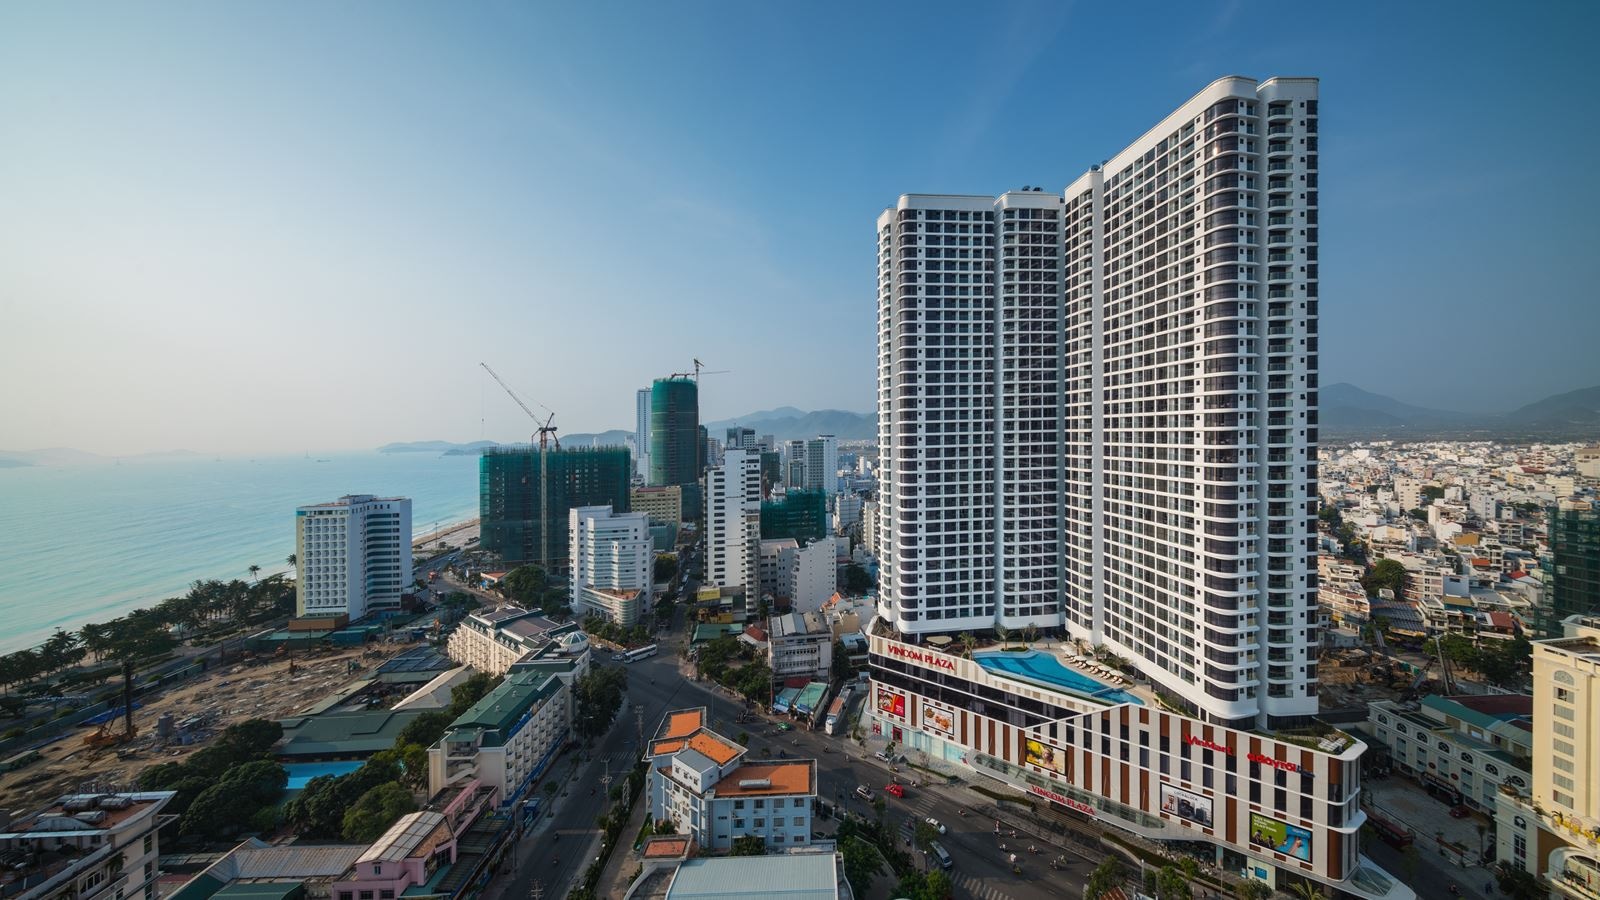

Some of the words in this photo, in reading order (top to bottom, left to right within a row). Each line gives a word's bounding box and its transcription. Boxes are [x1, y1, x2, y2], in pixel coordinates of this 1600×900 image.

[888, 645, 922, 661] VINCOM
[925, 655, 955, 671] PLAZA
[1184, 734, 1233, 756] VinMart
[1032, 786, 1065, 805] VINCOM
[1068, 799, 1096, 815] PLAZA
